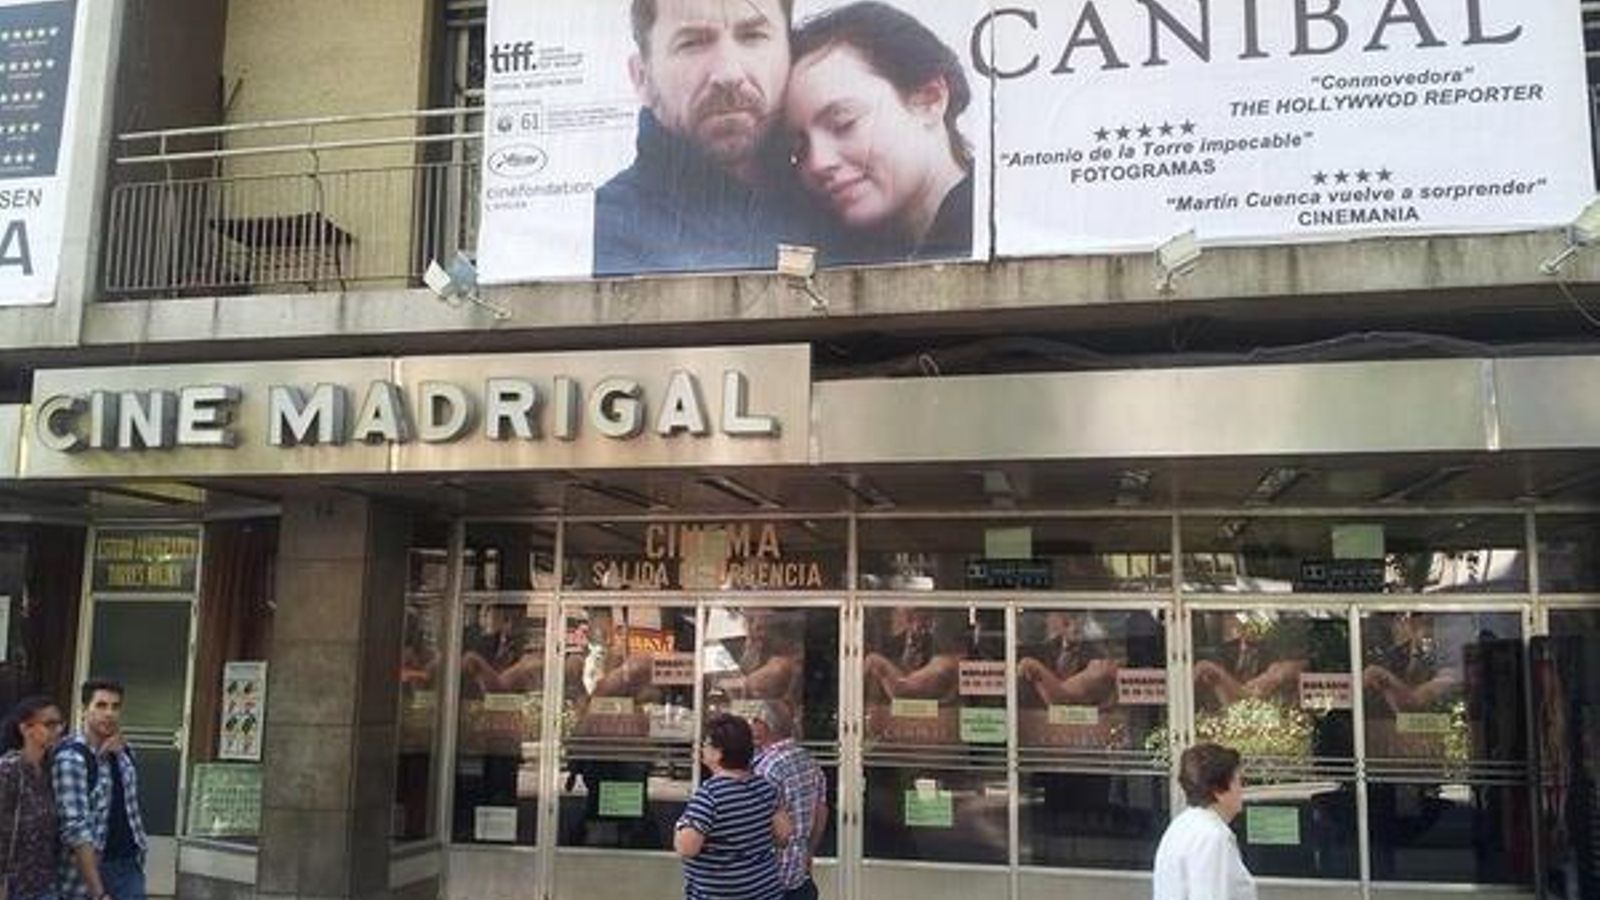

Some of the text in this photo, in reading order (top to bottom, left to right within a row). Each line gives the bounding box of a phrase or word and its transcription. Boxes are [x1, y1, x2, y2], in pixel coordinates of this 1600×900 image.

[1230, 84, 1544, 117] THE HOLLYWWOD REPORTER
[1089, 145, 1113, 162] de
[1118, 144, 1136, 159] la
[1143, 141, 1195, 157] Torre
[1070, 158, 1217, 184] FOTOGRAMAS
[1246, 191, 1321, 209] Cuenca
[1328, 186, 1396, 204] vuelve
[1401, 188, 1414, 200] a
[1298, 206, 1420, 226] CINEMANIA
[37, 370, 780, 451] CINE MADRIGAL
[593, 561, 669, 588] SALIDA
